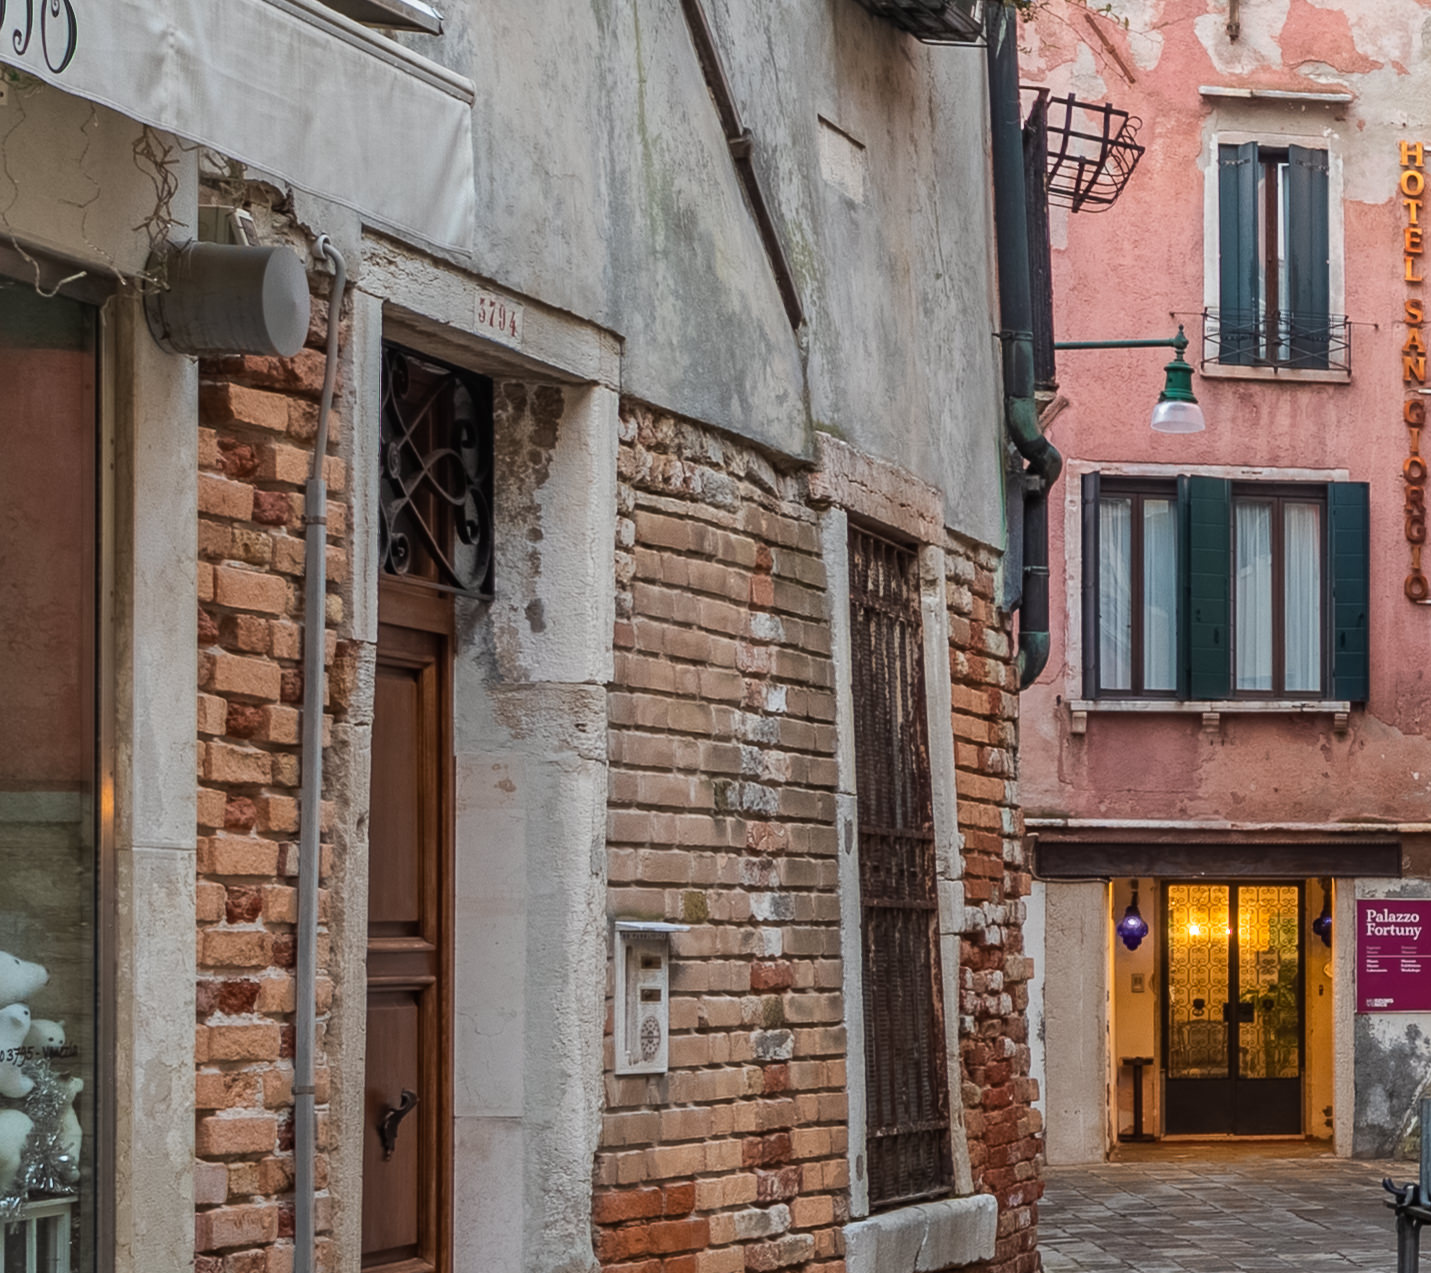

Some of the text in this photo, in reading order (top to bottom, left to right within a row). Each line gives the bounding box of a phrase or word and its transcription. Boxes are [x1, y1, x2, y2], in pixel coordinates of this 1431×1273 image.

[478, 297, 518, 338] 3794
[1399, 140, 1429, 602] HOTEL SAN GIORGIO
[1366, 908, 1420, 923] Palazzo
[1366, 923, 1422, 940] Fortuny
